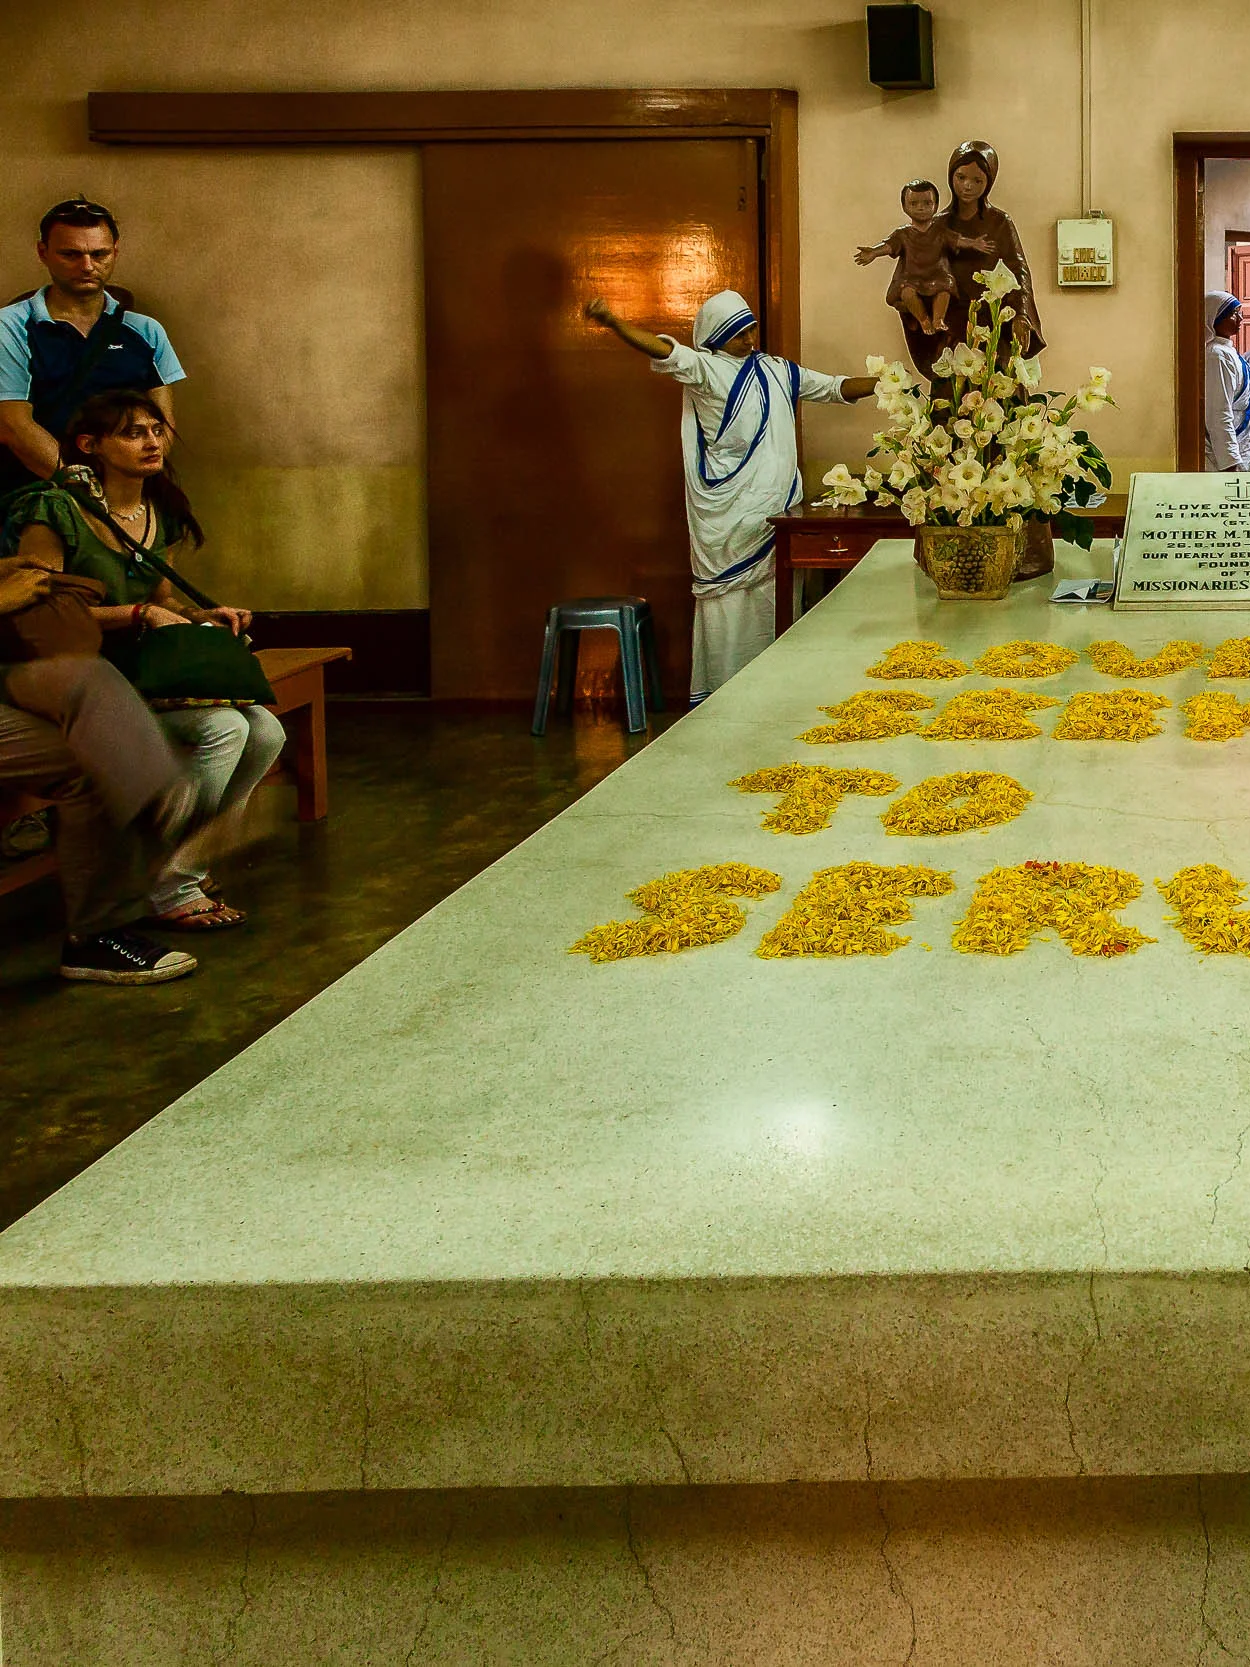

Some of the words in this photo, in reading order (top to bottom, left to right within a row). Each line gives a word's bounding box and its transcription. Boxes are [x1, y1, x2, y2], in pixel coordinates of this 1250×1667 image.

[1142, 530, 1217, 540] MOTHER
[1142, 552, 1169, 560] OUR
[1132, 579, 1250, 591] MISSIONARIES
[728, 762, 1035, 837] TO
